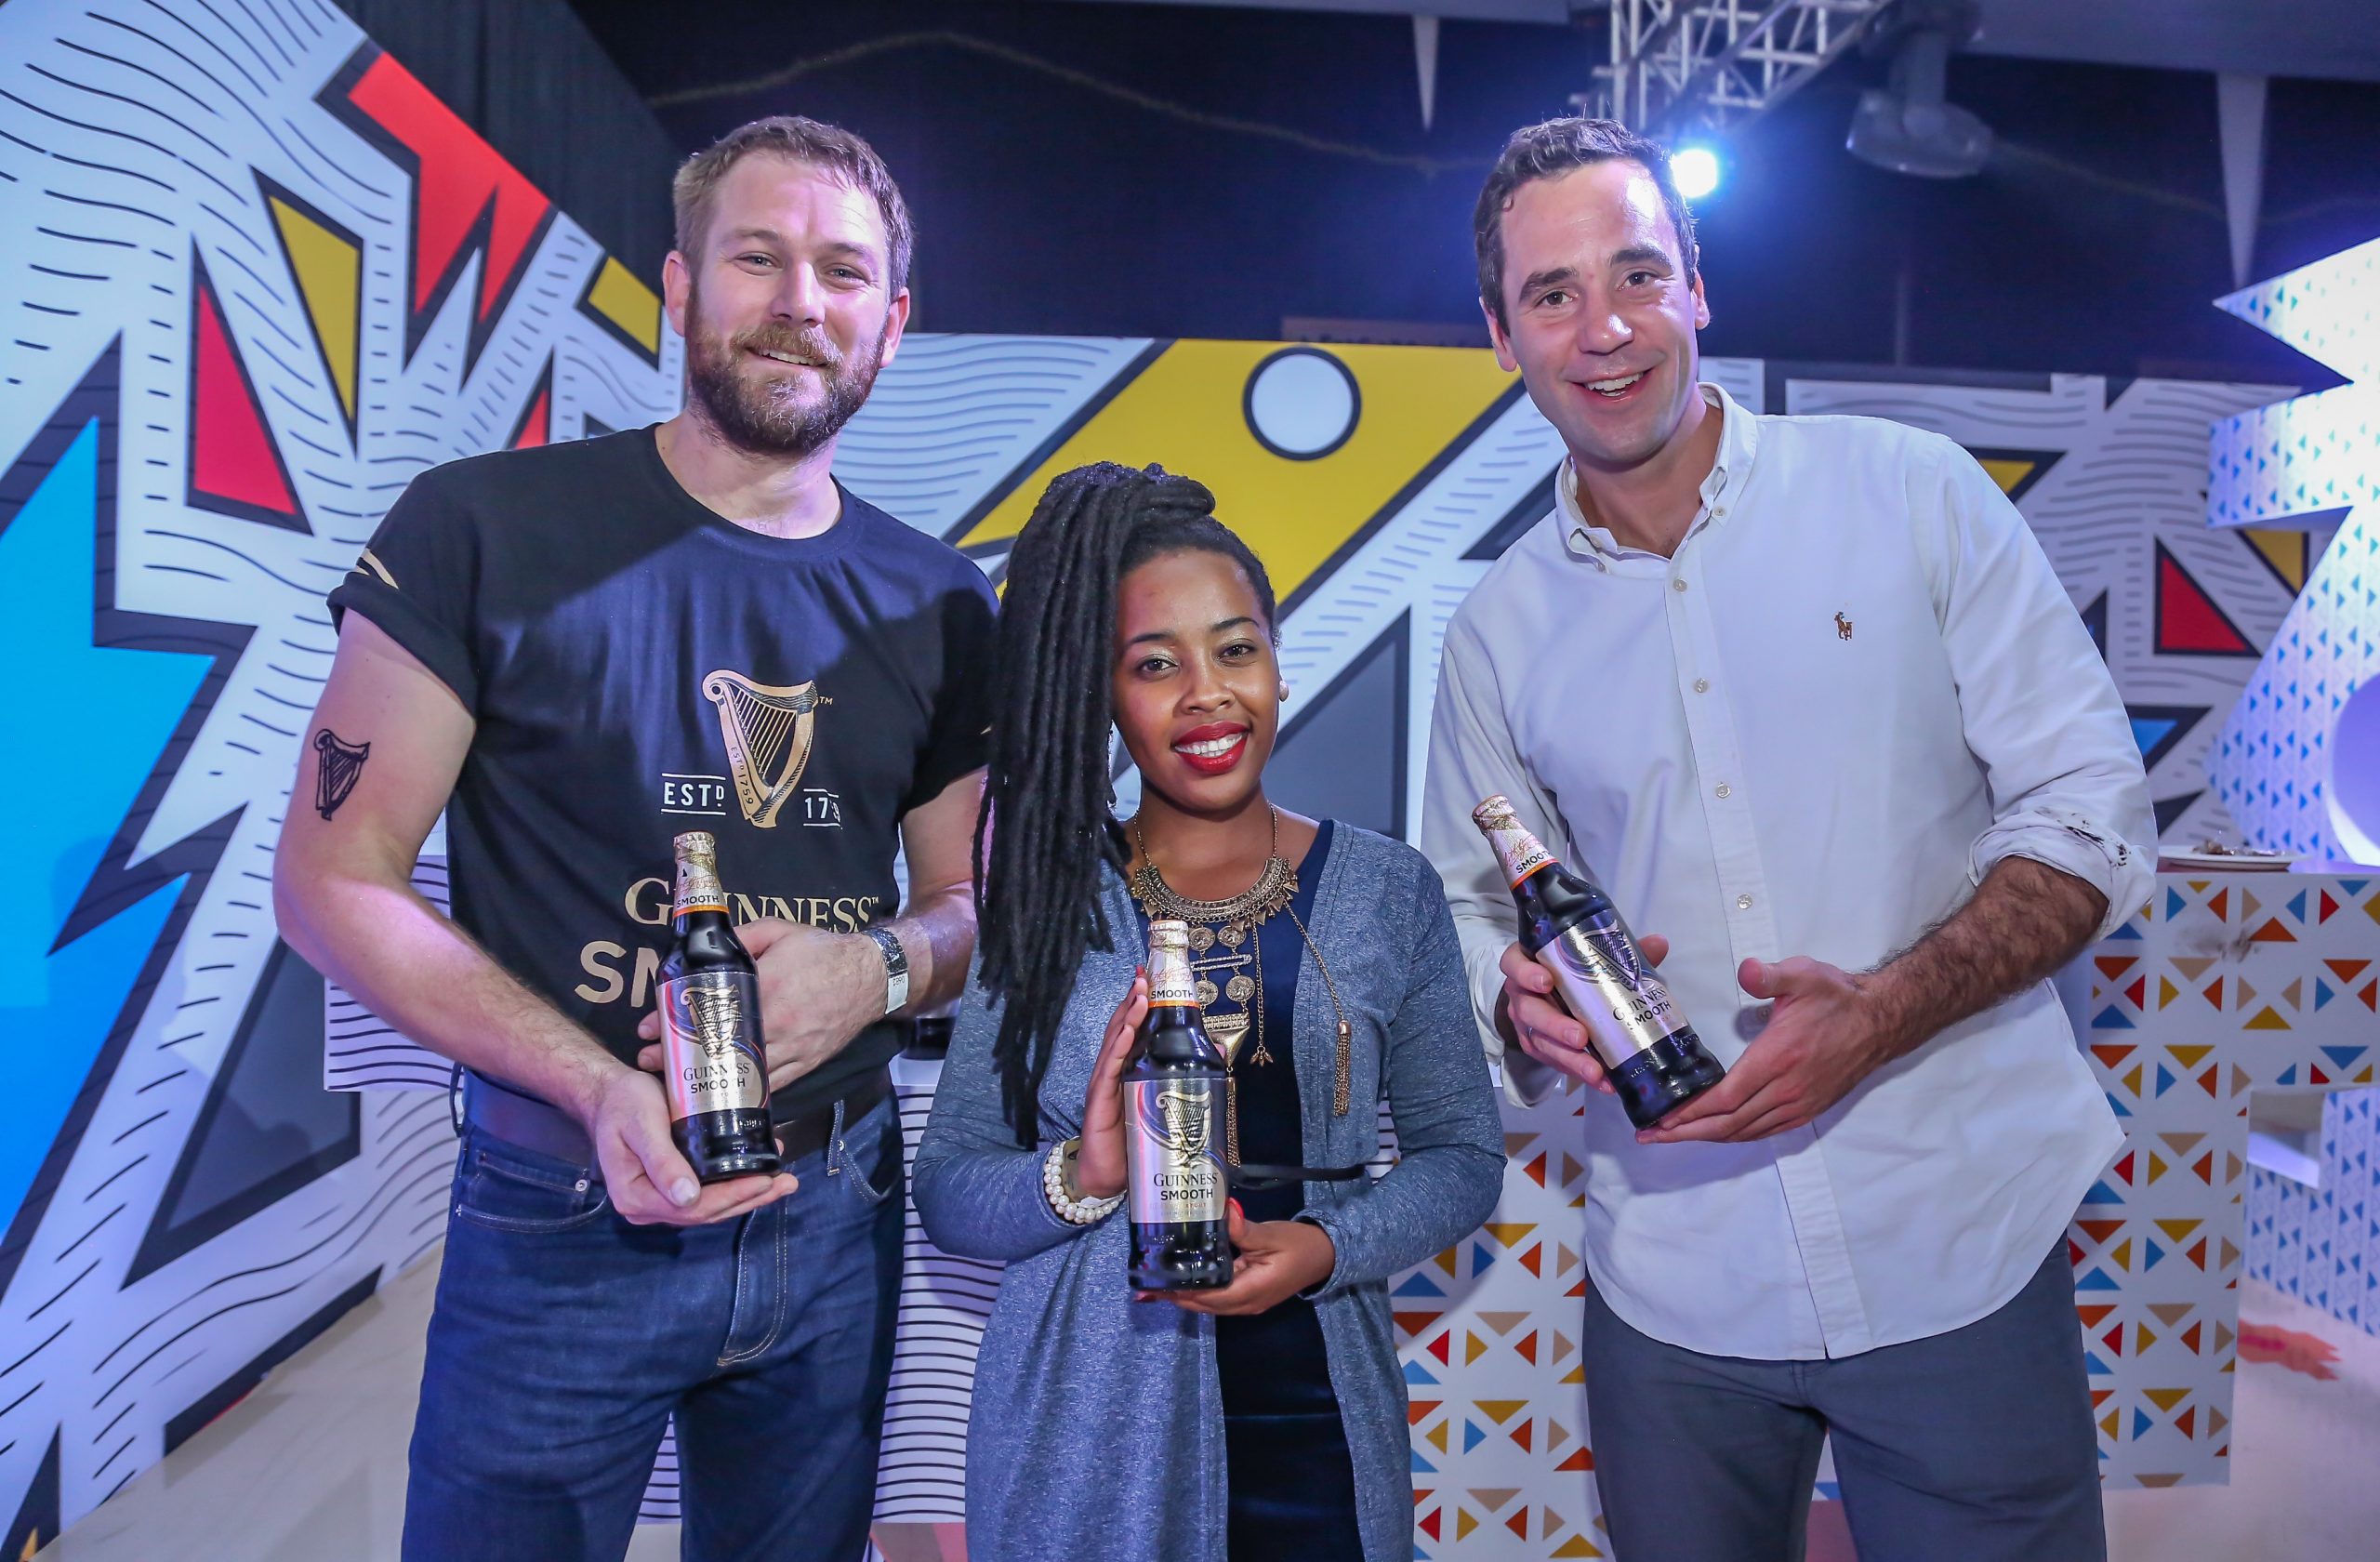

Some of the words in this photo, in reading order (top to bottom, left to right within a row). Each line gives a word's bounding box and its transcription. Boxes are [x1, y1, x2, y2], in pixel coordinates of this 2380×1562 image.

[1515, 850, 1550, 873] SMOOT
[677, 895, 720, 908] SMOOTH
[683, 1063, 750, 1081] GUINNSS
[691, 1078, 746, 1094] SMOOH
[1154, 1172, 1218, 1187] GUINNESS
[1160, 1189, 1213, 1201] SMOOTH
